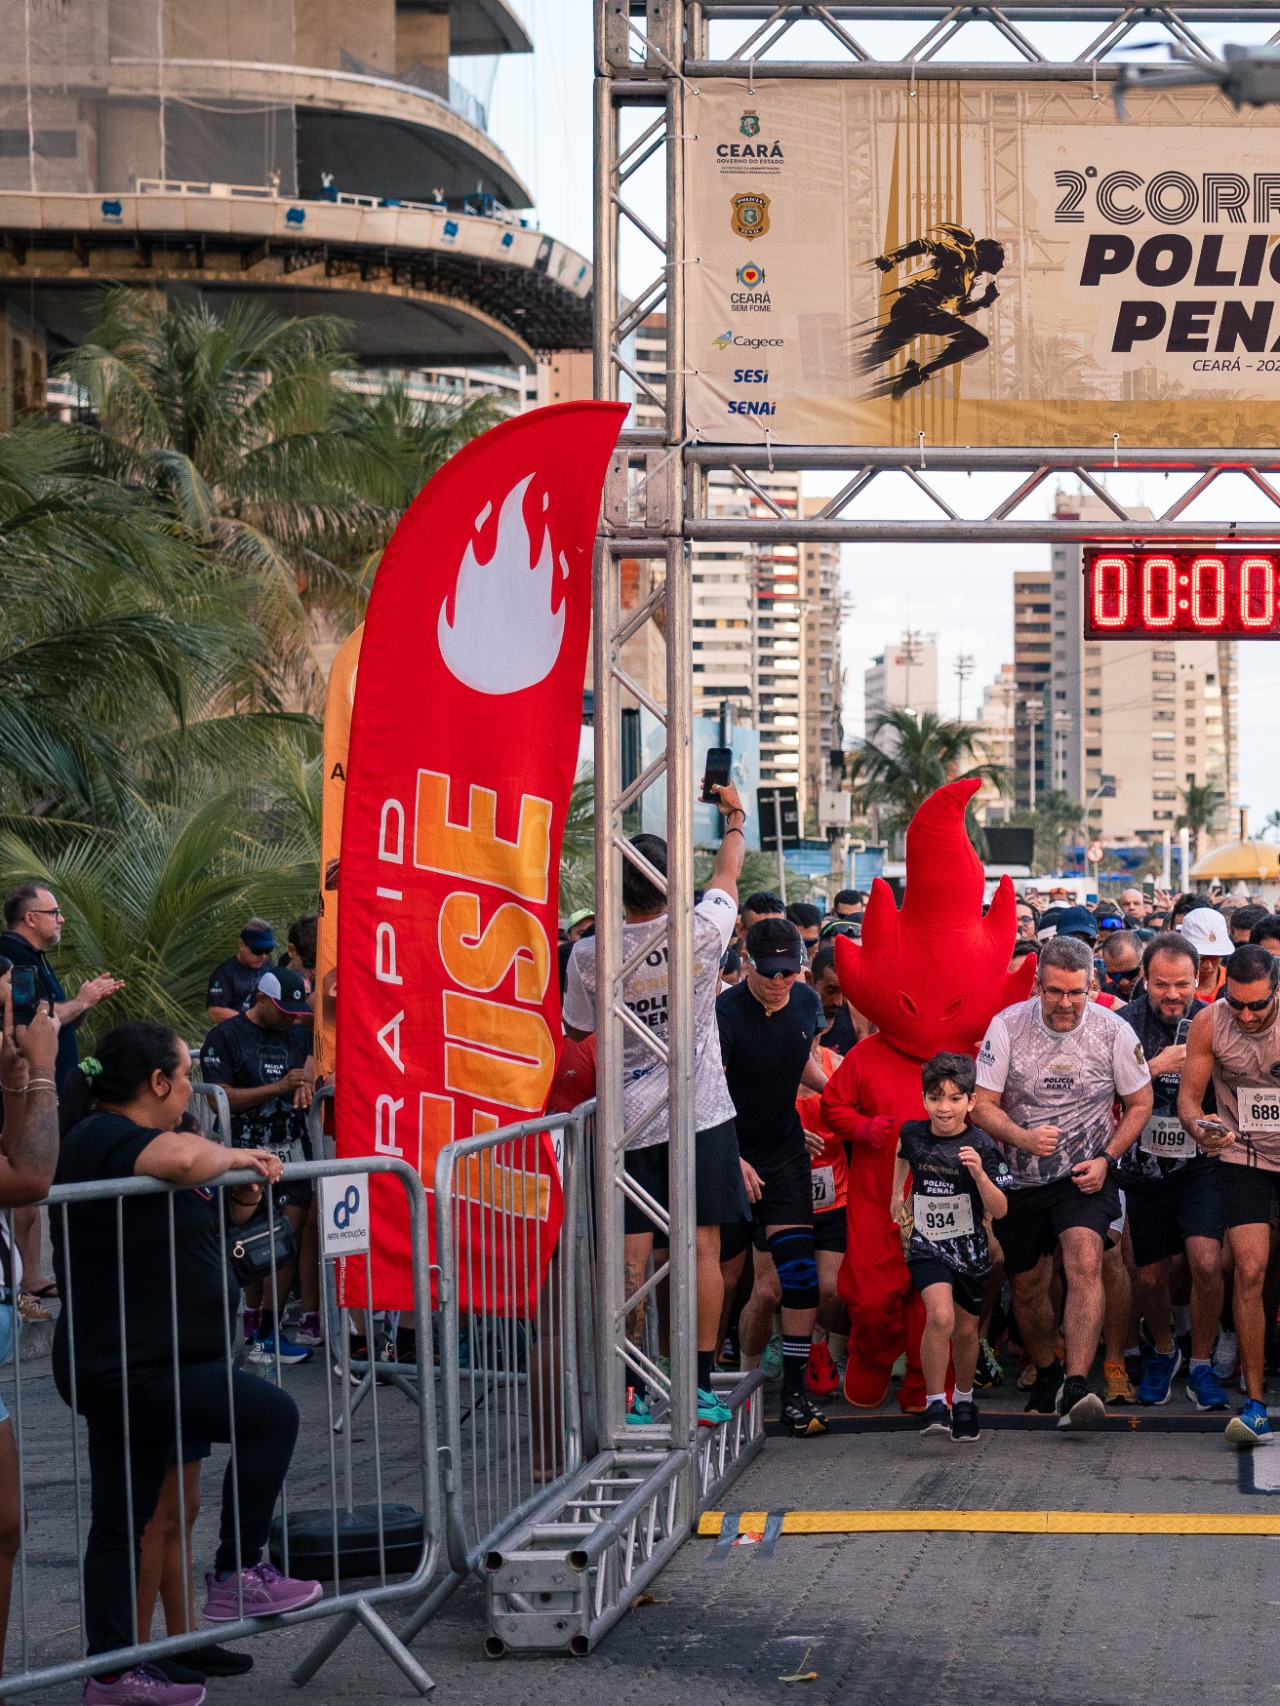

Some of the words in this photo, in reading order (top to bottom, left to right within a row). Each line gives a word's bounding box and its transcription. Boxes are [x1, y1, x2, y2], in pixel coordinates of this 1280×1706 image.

[716, 140, 784, 158] CEARÁ
[730, 291, 772, 304] CEARÁ
[731, 304, 748, 312] SEM
[749, 304, 772, 312] FOME
[733, 336, 784, 349] Cagece
[1192, 356, 1241, 372] CEARÁ
[374, 797, 405, 1158] RAPID
[412, 768, 555, 1222] FUSE
[1251, 1104, 1280, 1120] 688
[1150, 1129, 1186, 1146] 1099
[926, 1187, 955, 1195] PENAL
[926, 1212, 956, 1229] 934
